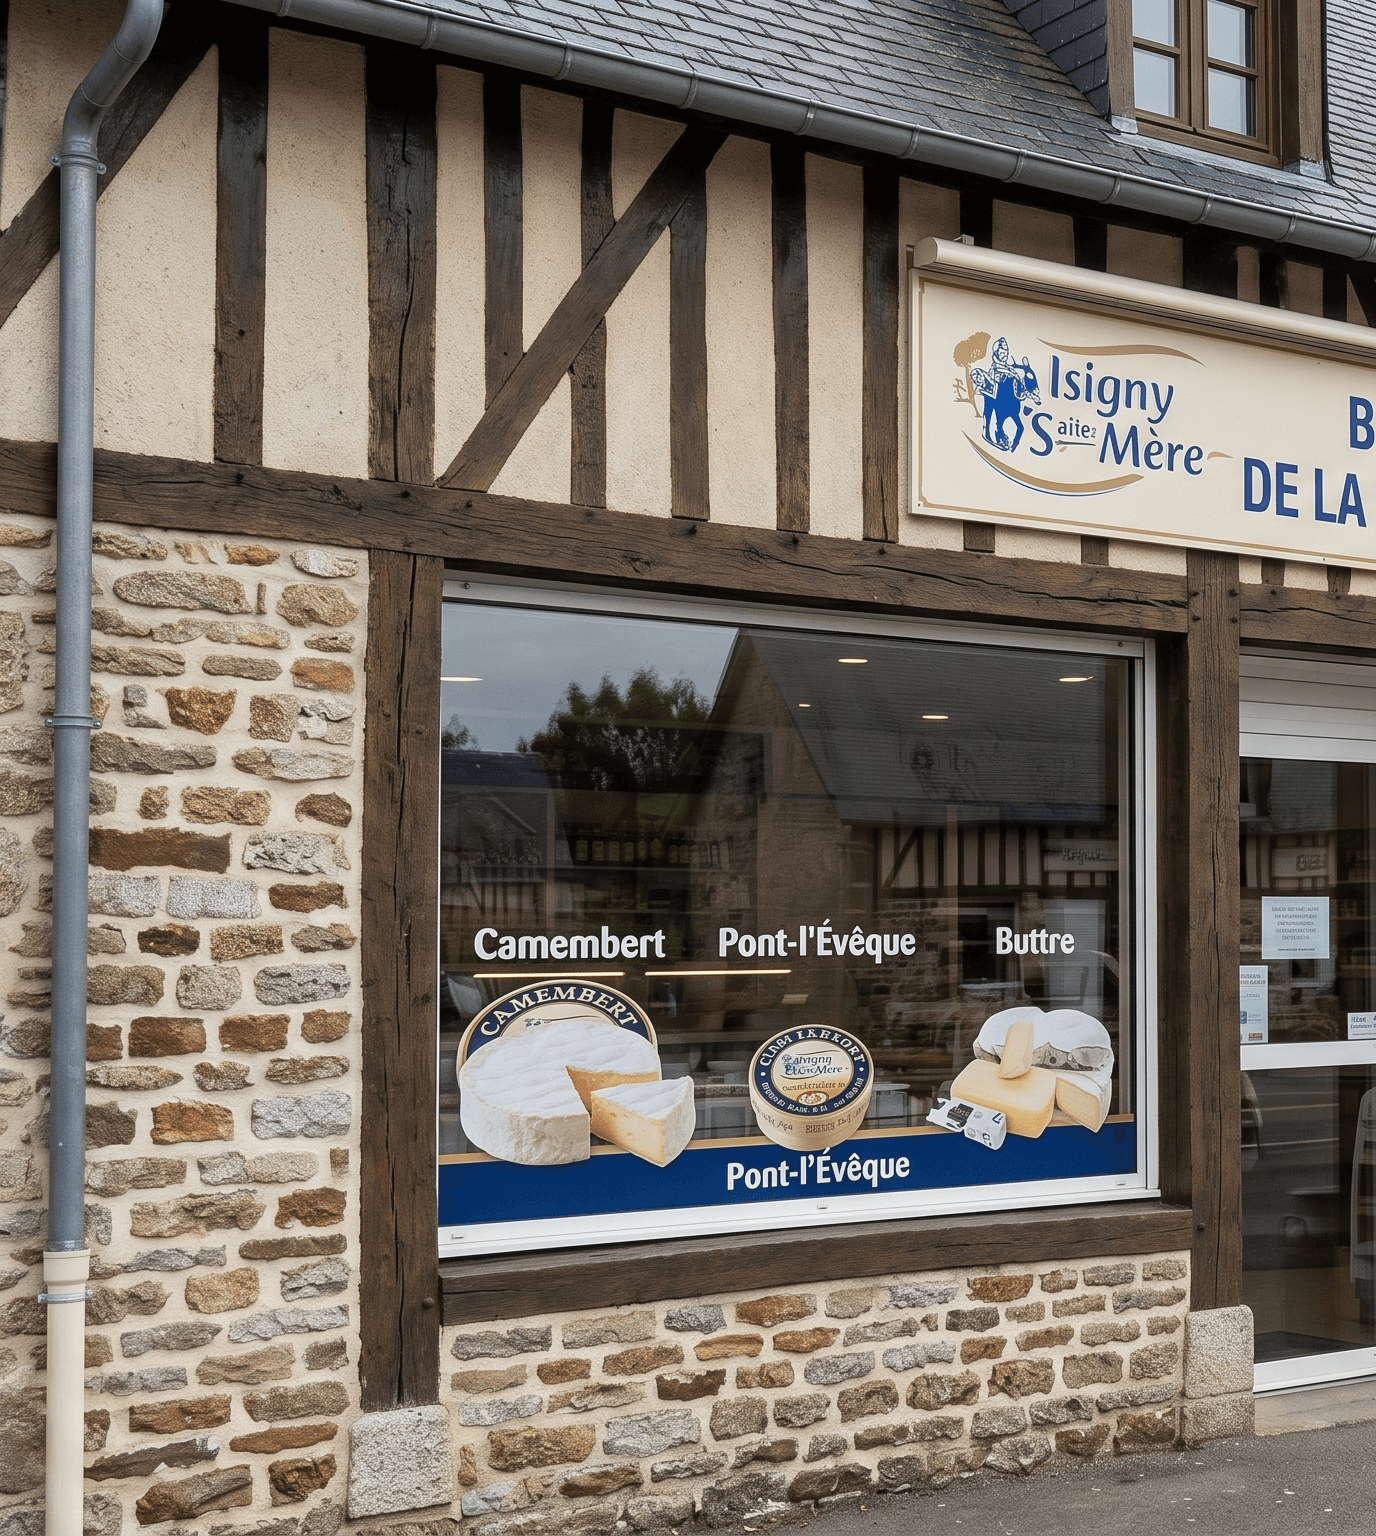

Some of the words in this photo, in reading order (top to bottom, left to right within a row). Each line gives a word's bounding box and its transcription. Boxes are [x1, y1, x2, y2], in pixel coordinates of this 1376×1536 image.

[1050, 354, 1174, 424] Isigny
[1098, 421, 1204, 476] Mère
[1243, 456, 1299, 519] DE
[1314, 467, 1367, 528] LA
[473, 925, 666, 960] Camembert
[719, 918, 916, 964] Pont-l'Évêque
[996, 926, 1075, 955] Buttre
[480, 986, 639, 1036] CAMEMBERT
[726, 1146, 910, 1191] Pont-l'Évêque
